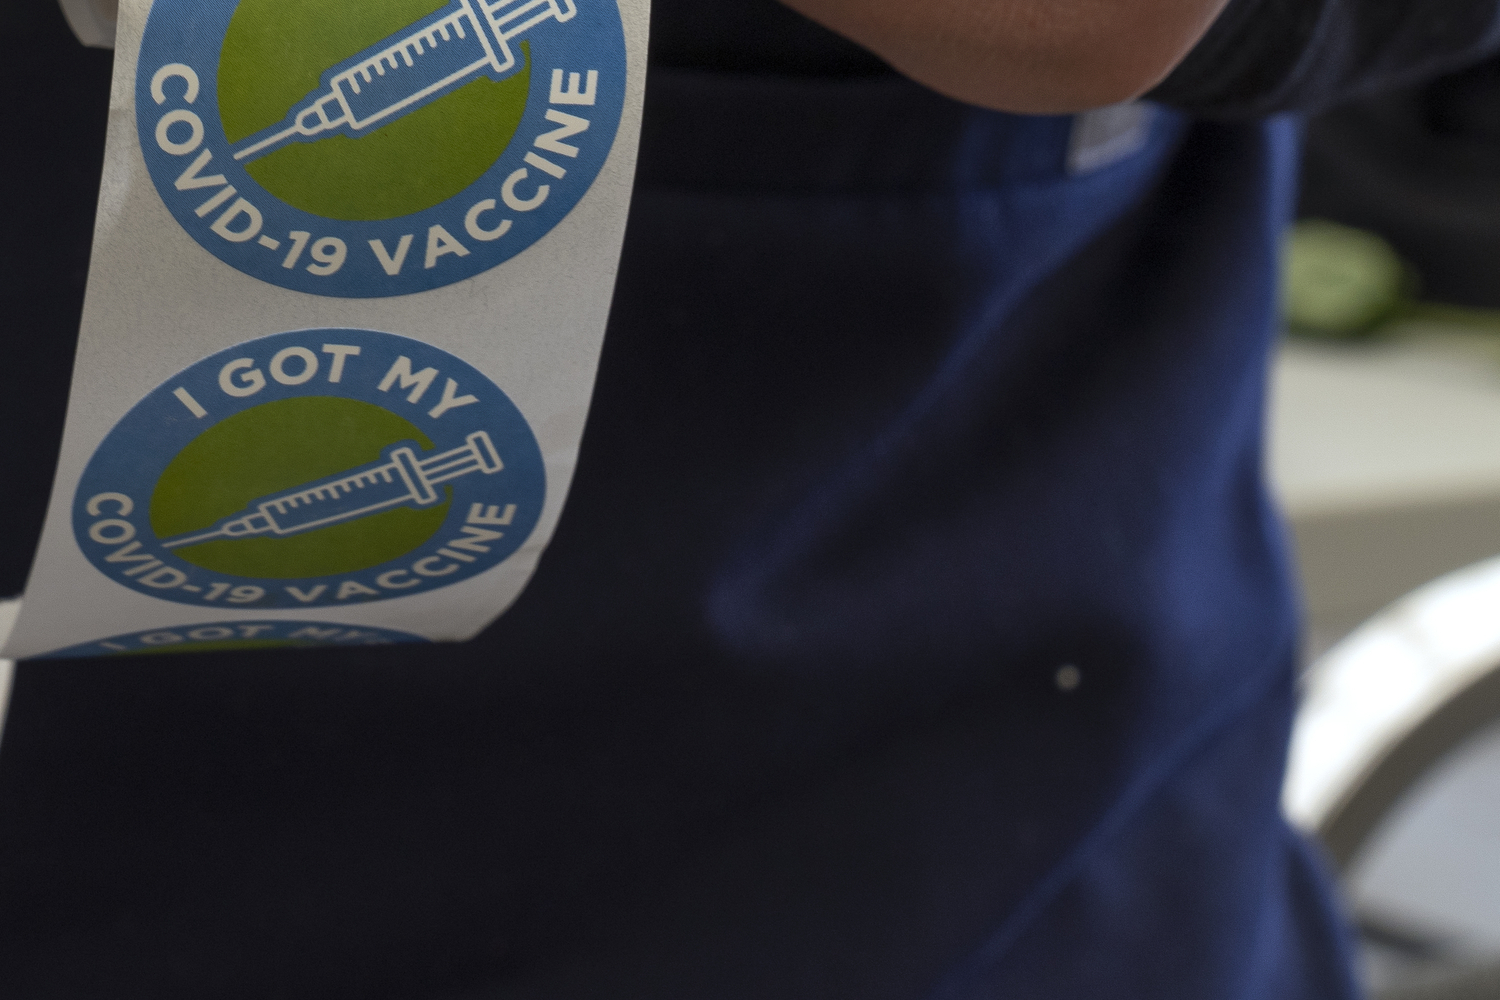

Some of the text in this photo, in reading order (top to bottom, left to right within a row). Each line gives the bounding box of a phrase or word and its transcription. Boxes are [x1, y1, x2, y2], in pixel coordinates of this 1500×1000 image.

[150, 63, 598, 277] COVID-19 VACCINE
[173, 343, 480, 419] I GOT MY
[86, 491, 518, 604] COVID-19 VACCINE
[140, 625, 274, 645] GOT
